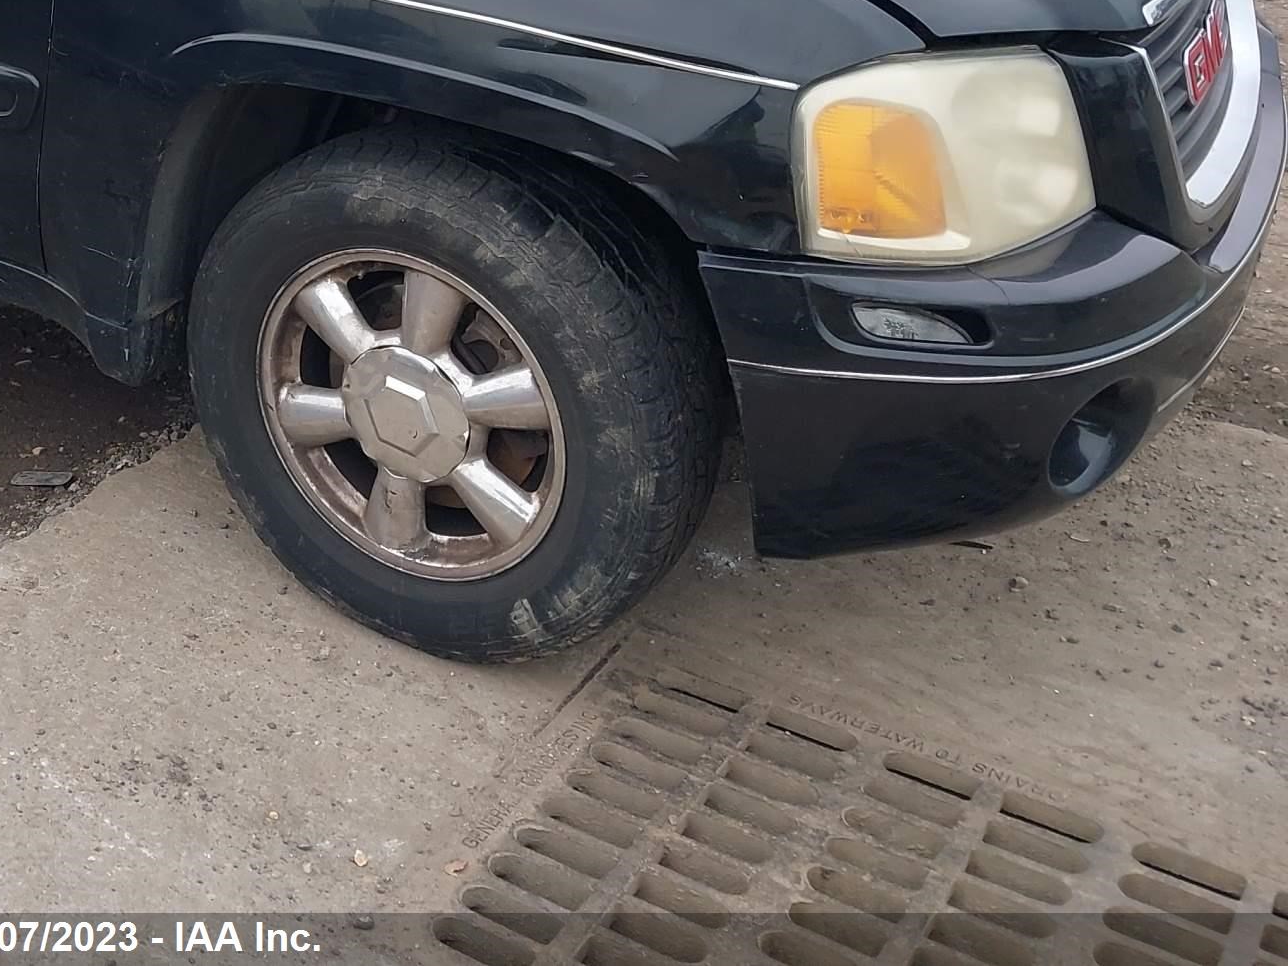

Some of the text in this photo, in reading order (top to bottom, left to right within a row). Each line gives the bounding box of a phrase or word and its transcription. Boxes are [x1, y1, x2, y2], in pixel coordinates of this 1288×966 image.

[788, 694, 1068, 803] DRAINS TO WATERWAYS
